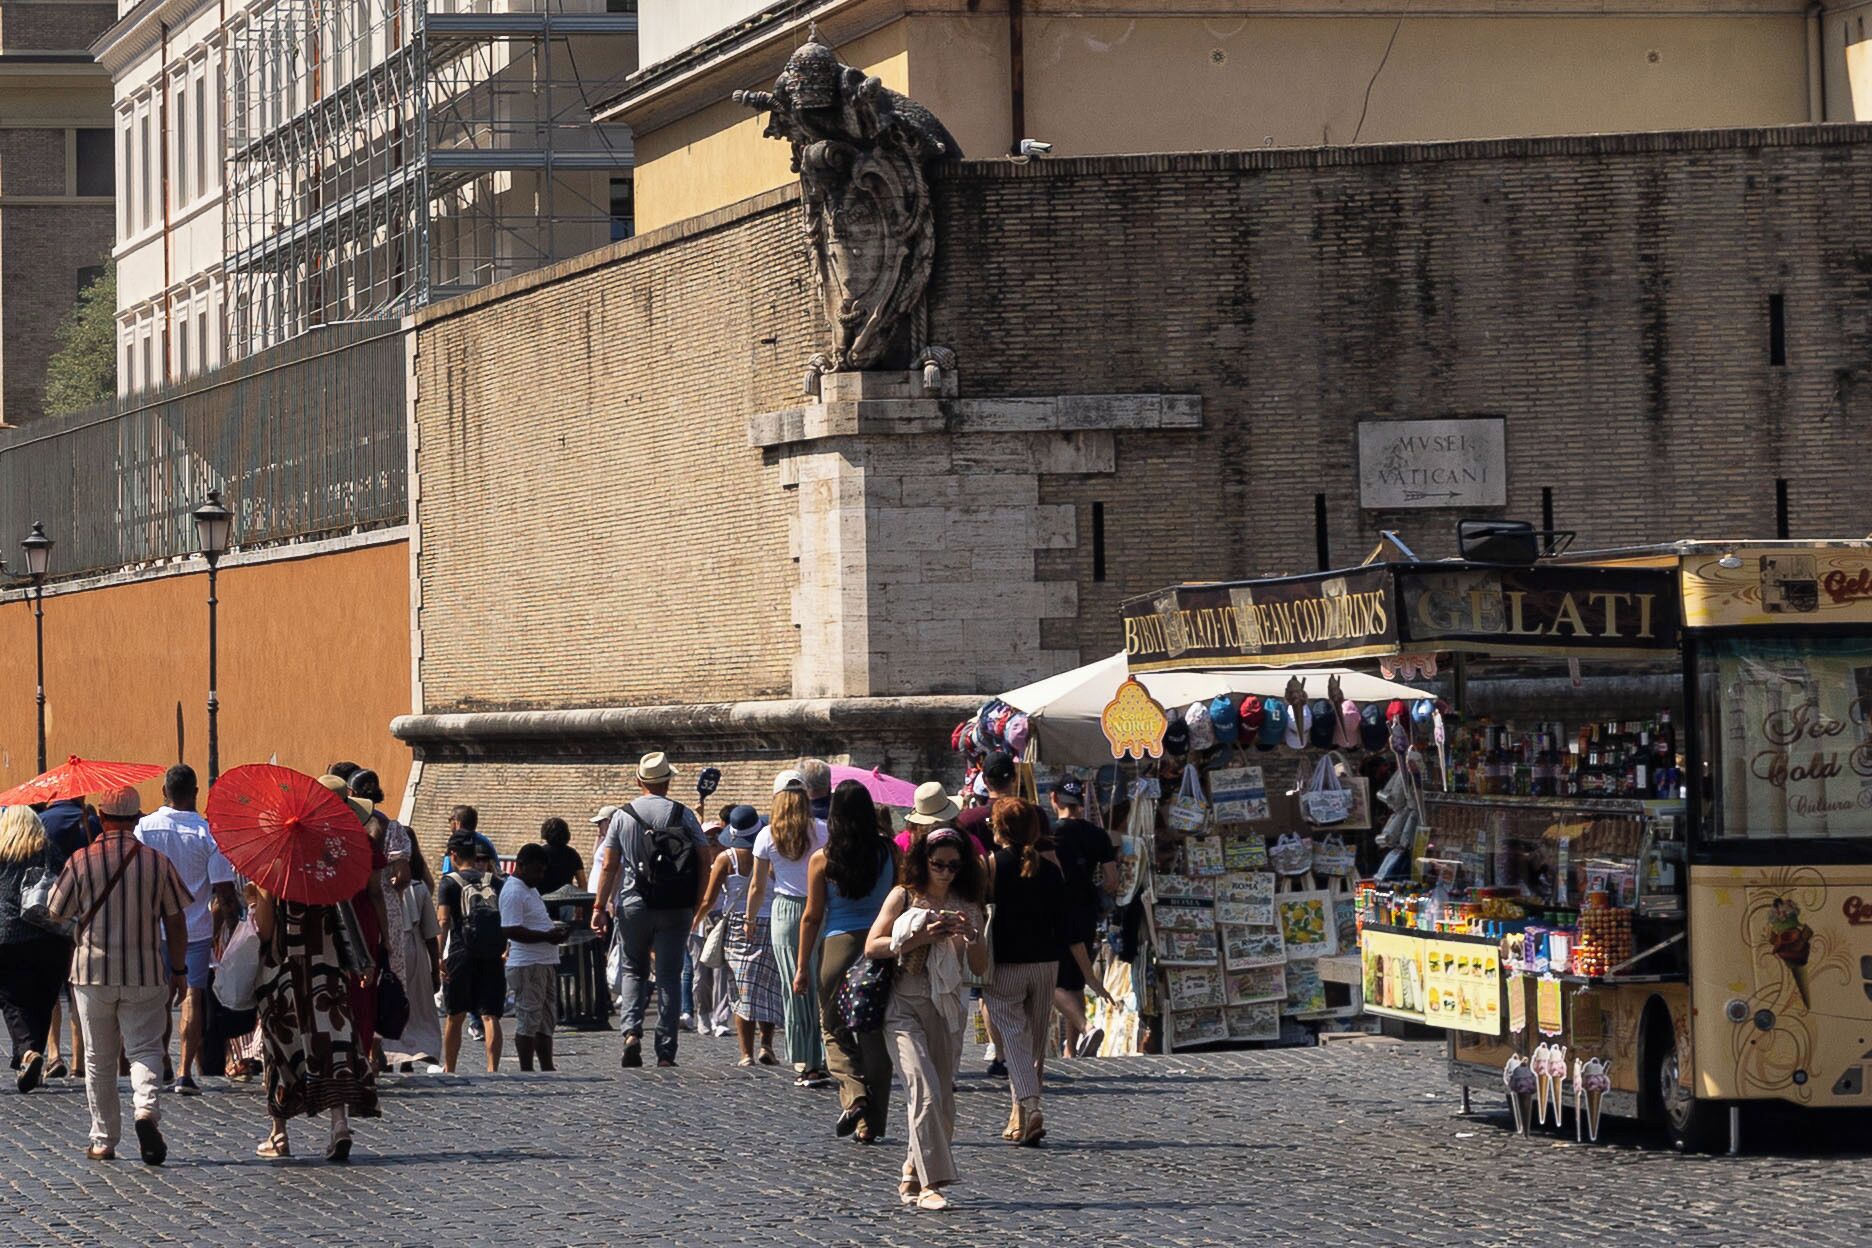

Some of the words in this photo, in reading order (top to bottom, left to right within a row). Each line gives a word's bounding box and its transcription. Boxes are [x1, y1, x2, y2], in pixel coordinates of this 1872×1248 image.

[1379, 468, 1488, 486] VATICANI
[1295, 598, 1331, 642] COLD
[1418, 589, 1656, 638] GELATI
[1763, 702, 1847, 746] Ice
[700, 778, 716, 791] 32
[1751, 750, 1843, 788] Cold
